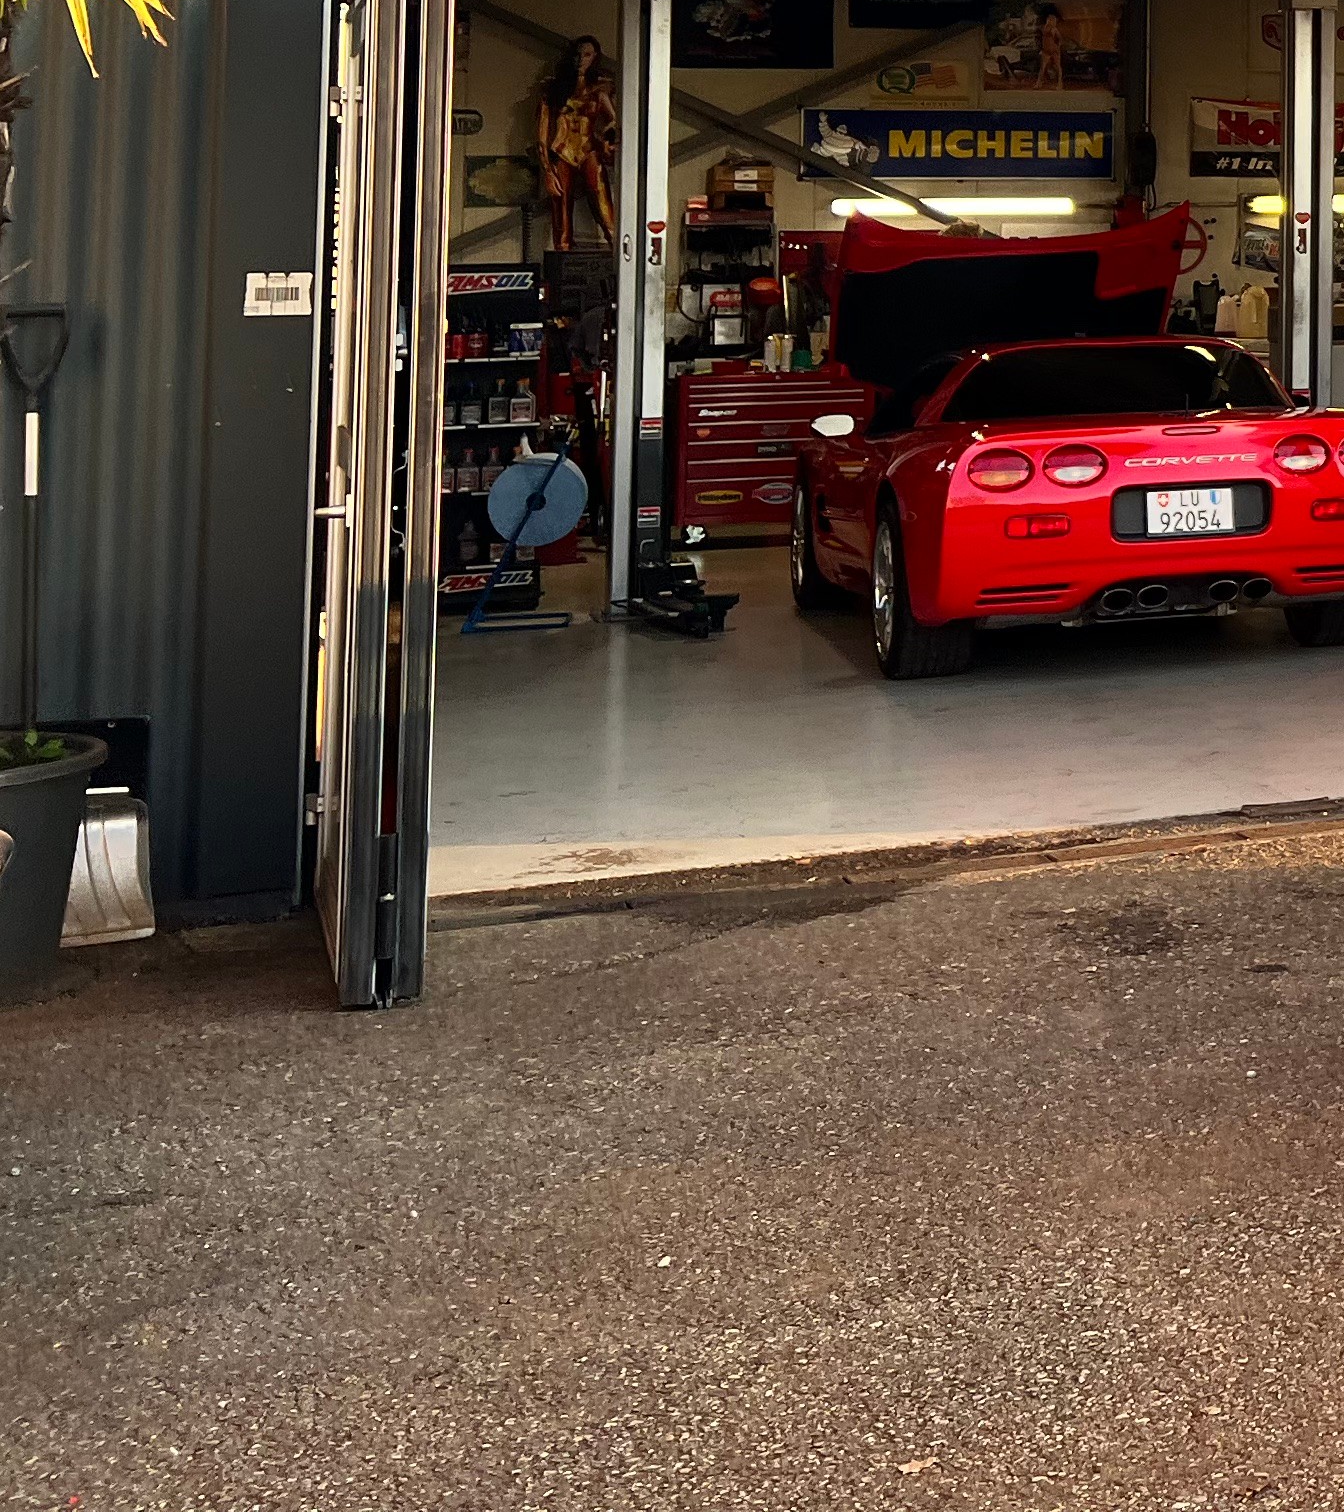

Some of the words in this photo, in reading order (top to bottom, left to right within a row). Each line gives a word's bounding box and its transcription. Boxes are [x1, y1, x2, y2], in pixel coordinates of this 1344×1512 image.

[887, 128, 1105, 160] MICHELIN
[1216, 156, 1241, 170] #1
[1247, 156, 1273, 170] In
[1124, 453, 1257, 467] CORVETTE
[1180, 491, 1200, 507] LU
[1159, 511, 1221, 533] 92054
